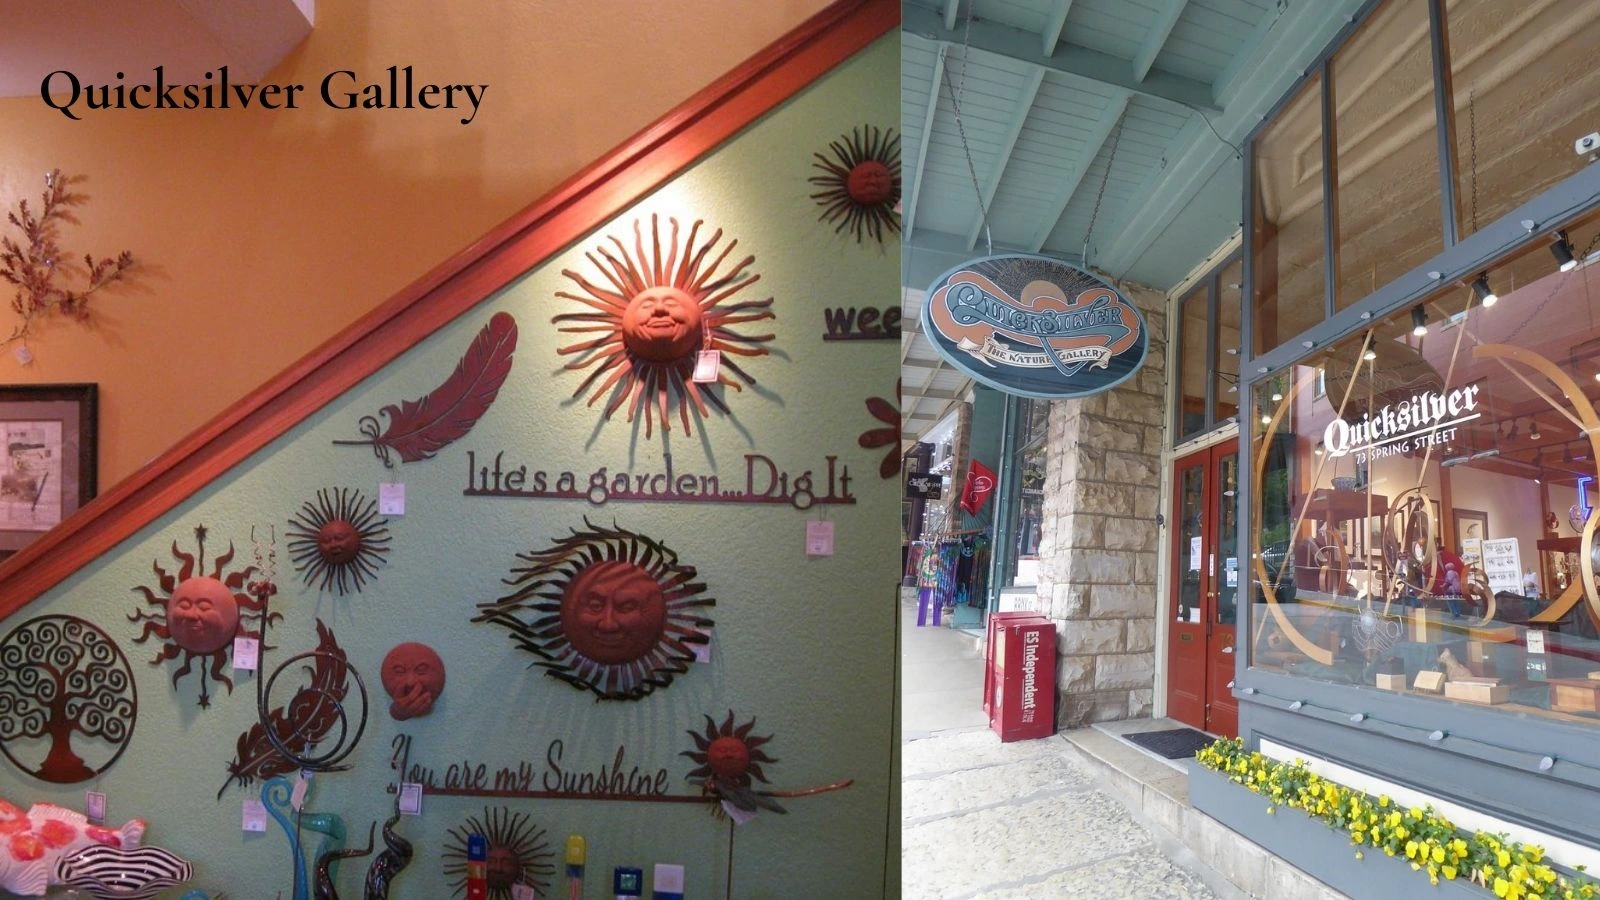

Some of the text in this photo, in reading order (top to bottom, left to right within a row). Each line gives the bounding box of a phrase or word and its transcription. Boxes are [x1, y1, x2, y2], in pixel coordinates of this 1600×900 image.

[986, 343, 1006, 360] THE
[1057, 349, 1107, 361] GALLERY
[1323, 383, 1480, 461] Quicksilver
[1355, 427, 1458, 465] 73 SPRING STREET
[556, 468, 576, 494] a
[825, 455, 853, 500] It
[1026, 630, 1040, 644] ES
[1022, 644, 1039, 710] Independent
[391, 733, 670, 796] You are my Sunshine
